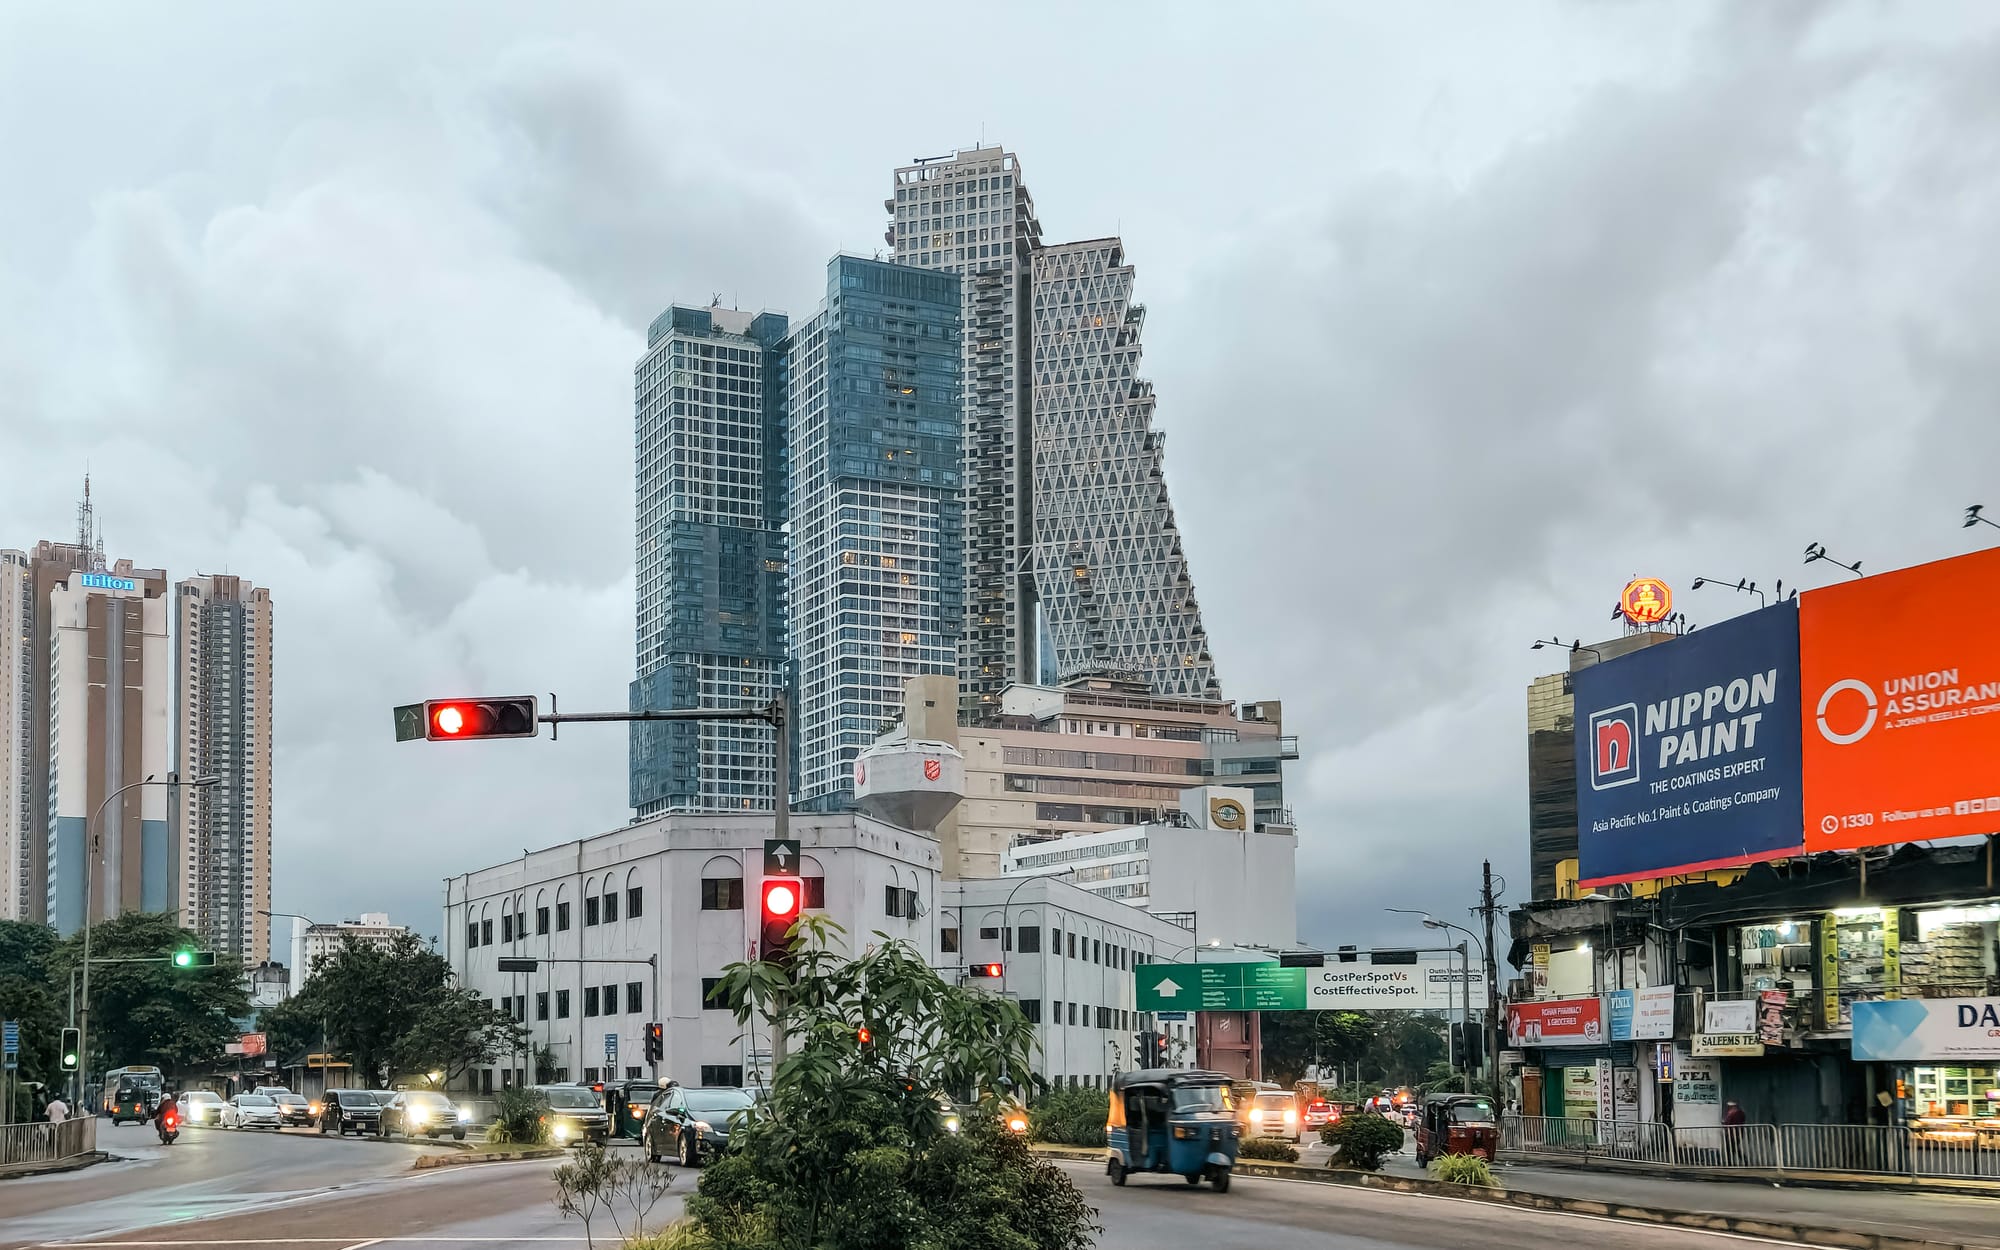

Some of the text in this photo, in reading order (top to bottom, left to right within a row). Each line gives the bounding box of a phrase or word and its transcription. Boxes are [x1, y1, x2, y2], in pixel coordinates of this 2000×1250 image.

[81, 573, 135, 591] Hilton
[1884, 668, 1959, 696] UNION
[1645, 668, 1777, 736] NIPPON
[1884, 682, 2000, 716] ASSURAN
[1885, 721, 1894, 730] A
[1895, 715, 1926, 728] JOHN
[1659, 712, 1762, 769] PAINT
[1650, 757, 1766, 795] THE COATINGS EXPERT
[1592, 786, 1781, 833] Asia Pacific No.1 Paint & Coatings Company
[1882, 805, 1952, 823] Follow us on
[1841, 813, 1874, 829] 1330
[1323, 972, 1408, 983] CostPerSpotVs
[1313, 985, 1419, 997] CostEffectiveSpot.
[1958, 1003, 2000, 1028] DA
[1702, 1036, 1740, 1047] SALEEMS
[1679, 1071, 1711, 1081] TEA
